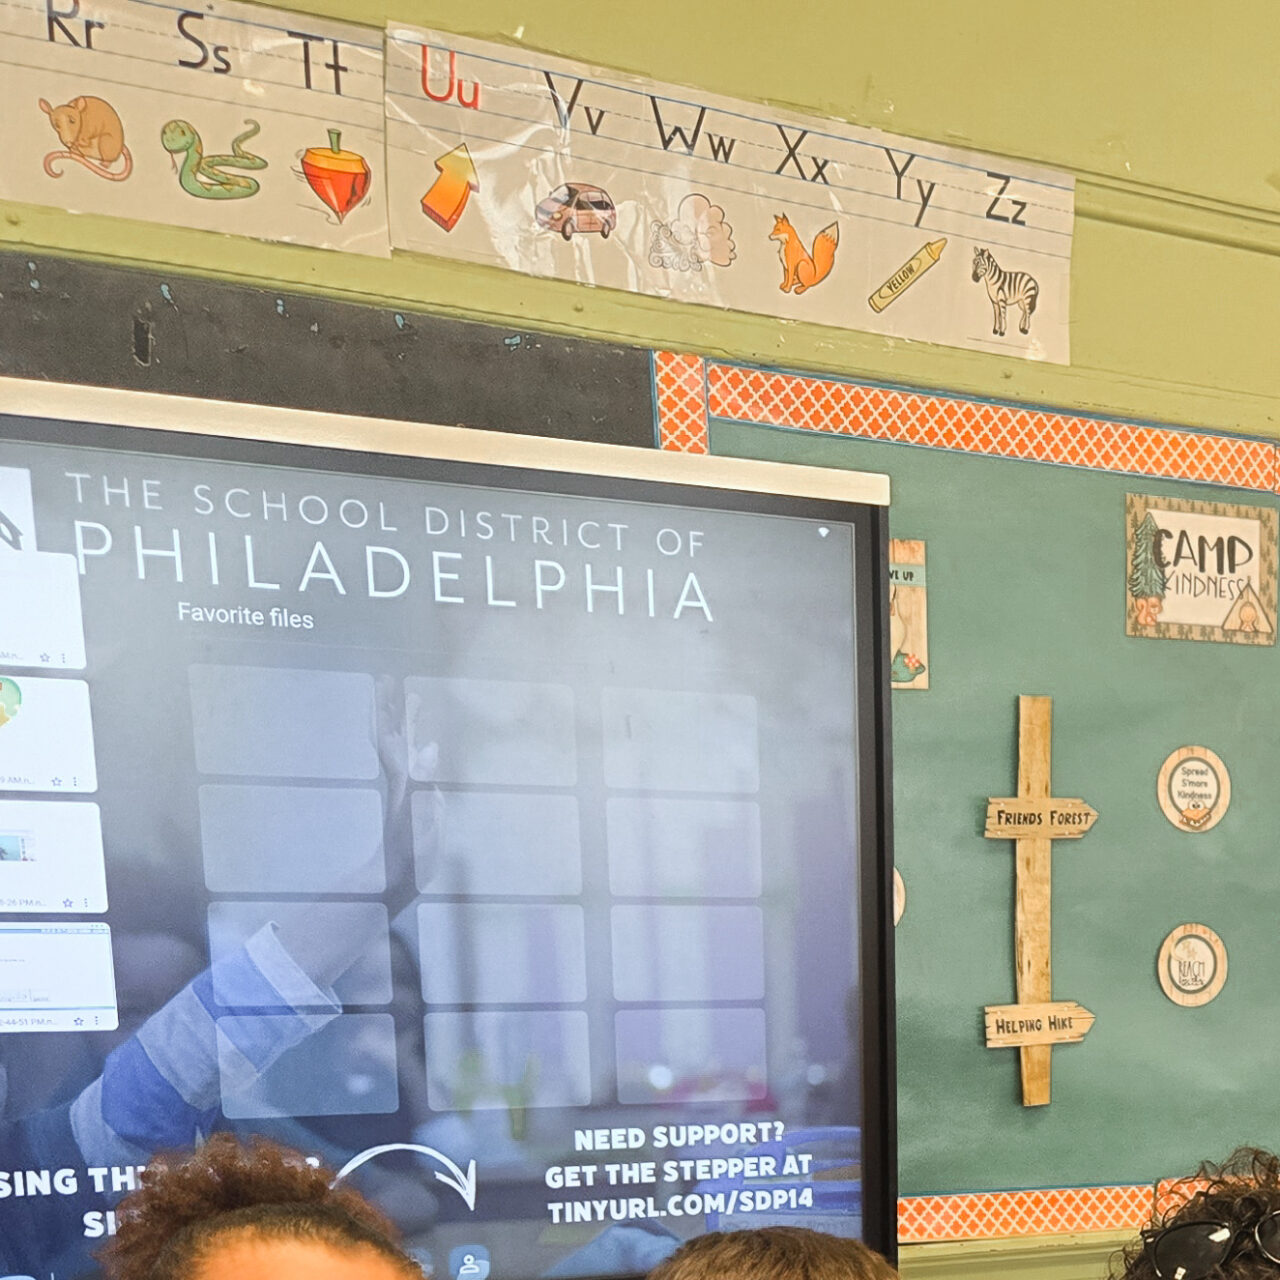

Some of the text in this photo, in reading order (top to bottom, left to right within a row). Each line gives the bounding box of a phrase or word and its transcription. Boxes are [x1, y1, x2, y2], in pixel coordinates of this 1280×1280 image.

[46, 0, 1027, 228] Rr Ss Tt Uu Vv Ww Xx Yy Zz
[886, 263, 915, 294] YELLOW
[64, 471, 706, 558] THE SCHOOL DISTRICT OF
[1152, 528, 1254, 576] CAMP
[73, 519, 714, 623] PHILADELPHIA
[889, 569, 914, 581] VE UP
[177, 602, 315, 630] Favorite files
[1181, 766, 1209, 776] Spread
[574, 1121, 785, 1152] NEED SUPPORT?
[544, 1153, 813, 1189] GET THE STEPPER AT
[547, 1187, 814, 1225] TINYURL.COM/SDP14
